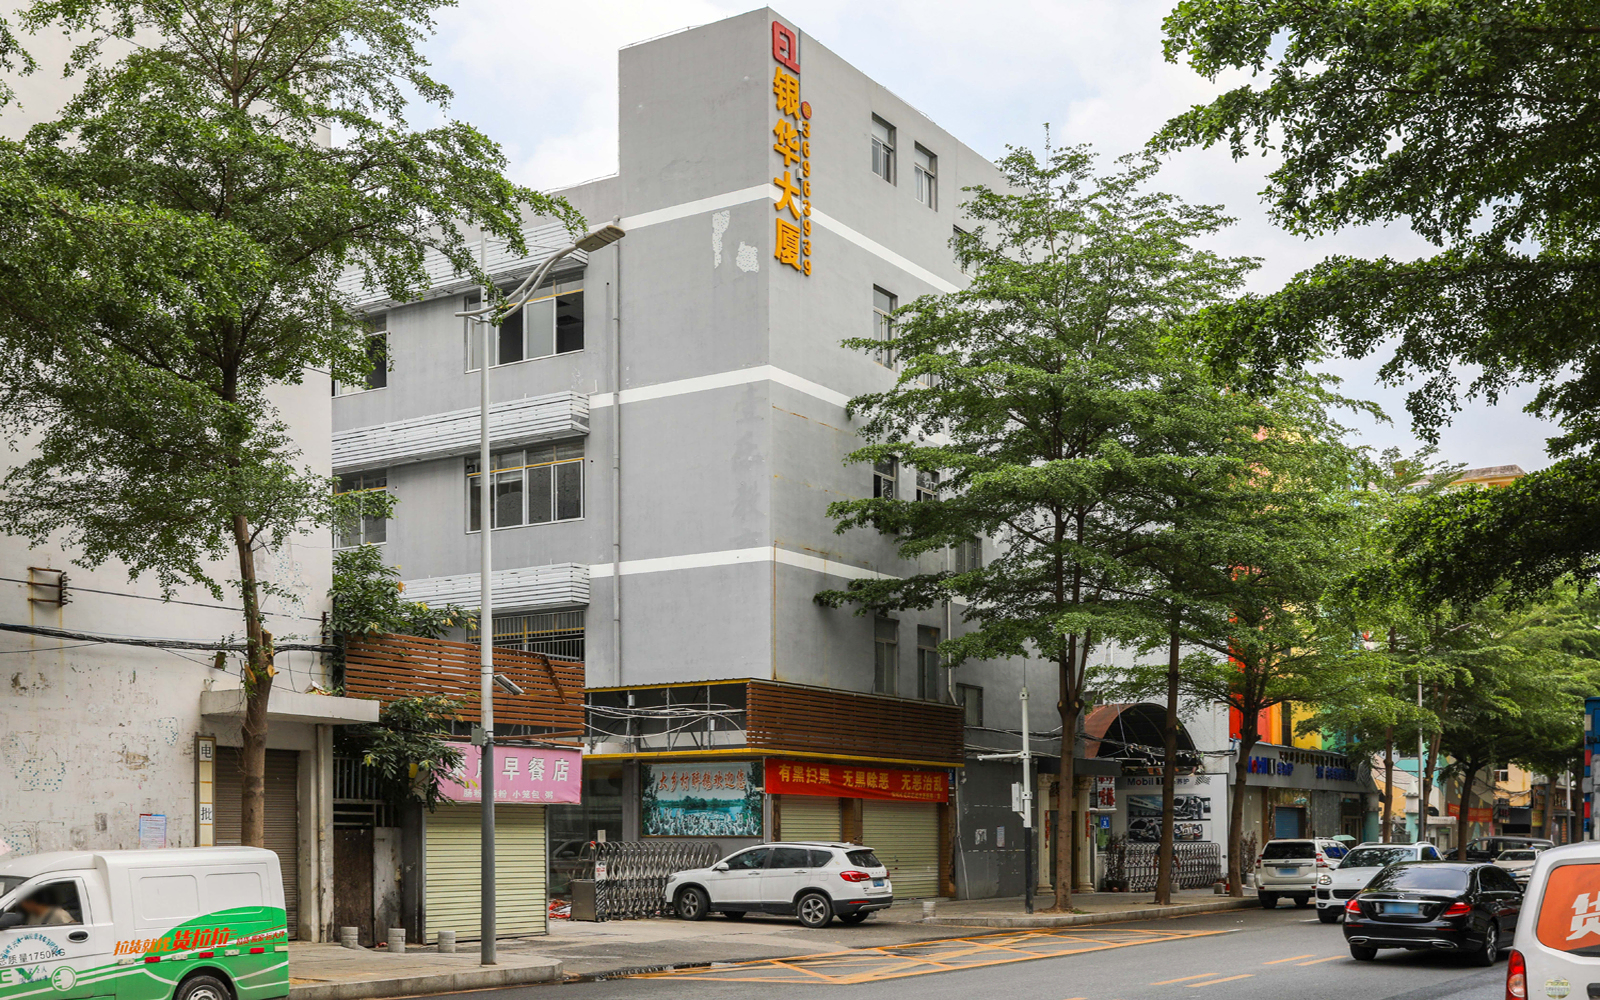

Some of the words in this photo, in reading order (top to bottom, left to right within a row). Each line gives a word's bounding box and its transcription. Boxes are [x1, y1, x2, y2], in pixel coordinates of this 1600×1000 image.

[773, 66, 801, 272] 银华大厦
[802, 121, 812, 276] 36963939
[201, 744, 212, 758] 电
[778, 764, 831, 785] 有黑扫黑
[842, 770, 889, 790] 无黑除恶
[901, 774, 943, 792] 无恶治乱
[1127, 777, 1154, 786] Mobil
[512, 790, 540, 799] 小笼包
[544, 791, 554, 799] 粥
[201, 806, 212, 821] 批
[172, 927, 231, 951] 货拉拉
